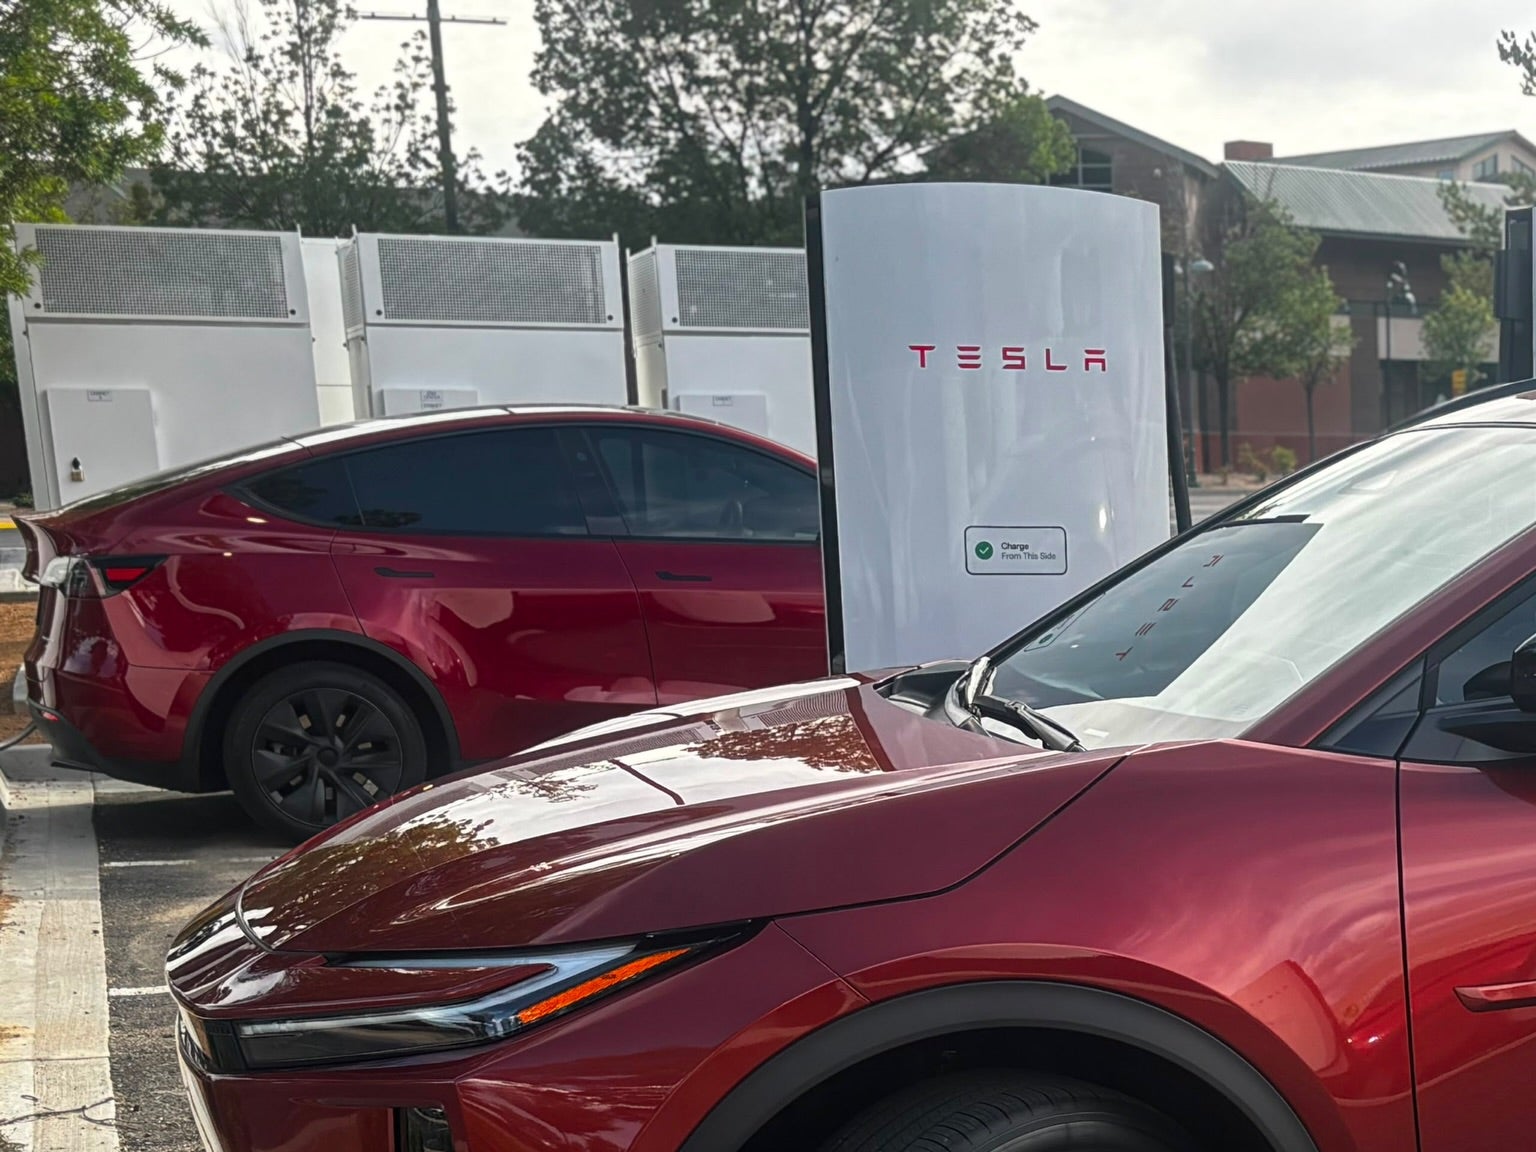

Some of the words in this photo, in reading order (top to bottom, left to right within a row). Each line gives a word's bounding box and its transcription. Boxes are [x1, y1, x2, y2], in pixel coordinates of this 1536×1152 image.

[908, 345, 1107, 372] TESLA
[1000, 541, 1030, 552] Charge
[1001, 552, 1022, 560] From
[1023, 552, 1039, 560] This
[1039, 551, 1057, 560] Side
